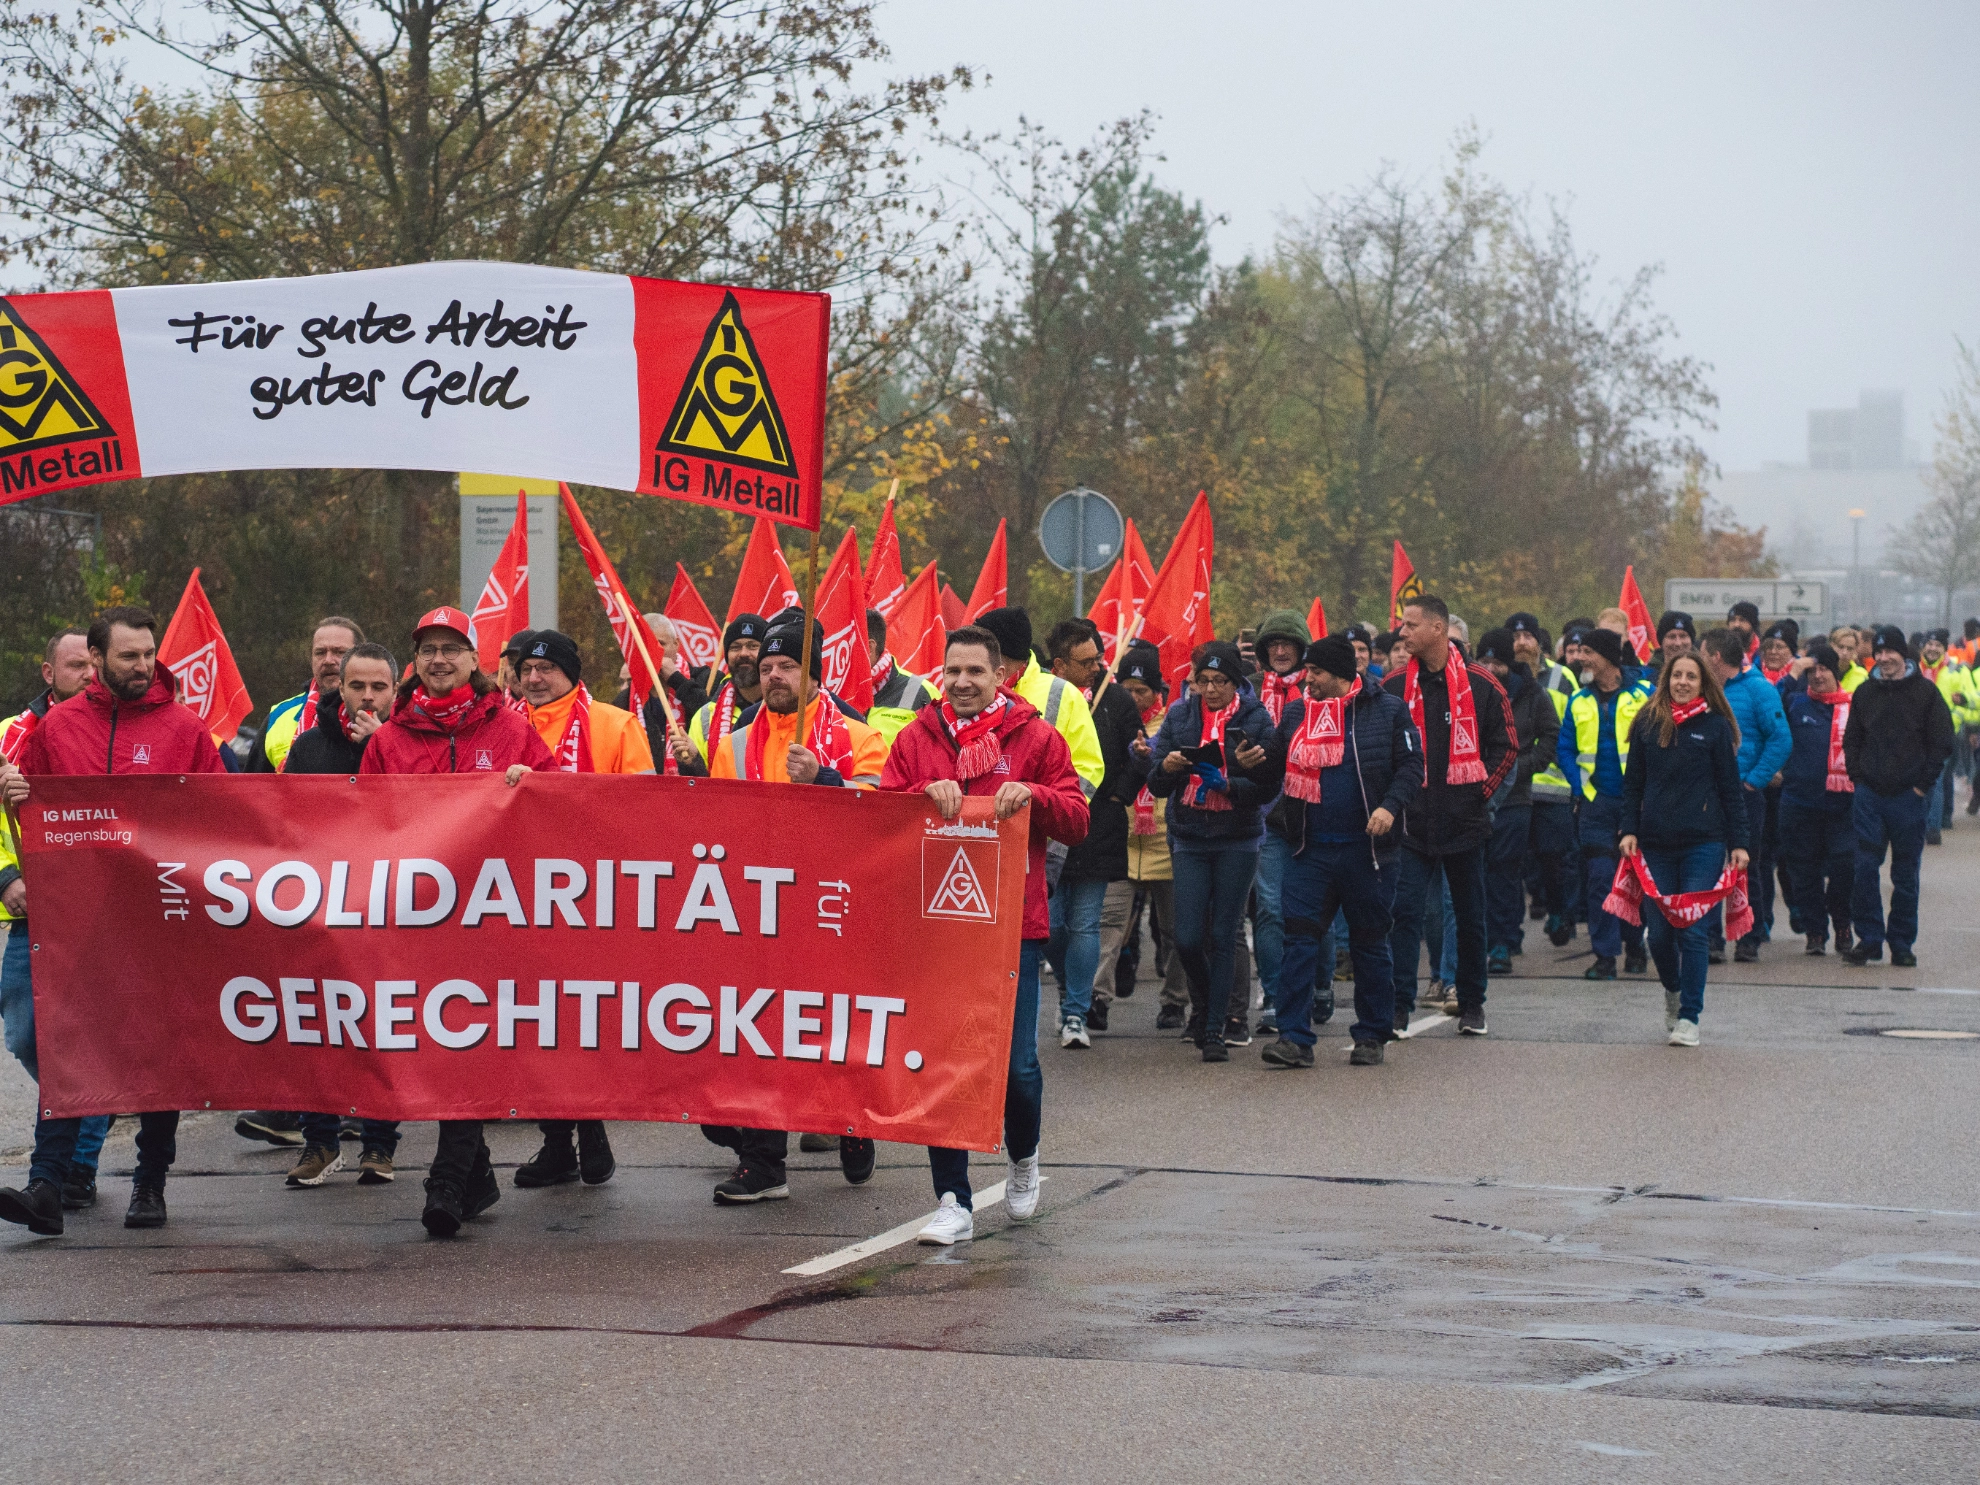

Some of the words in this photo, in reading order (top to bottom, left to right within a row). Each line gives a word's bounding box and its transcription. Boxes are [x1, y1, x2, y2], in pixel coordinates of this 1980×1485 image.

[168, 311, 284, 353] Für
[297, 301, 415, 358] gute
[425, 299, 587, 351] Arbeit
[401, 359, 530, 419] Geld
[1, 440, 123, 494] Metall
[652, 454, 690, 492] IG
[702, 464, 800, 517] Metall
[43, 810, 59, 822] IG
[62, 808, 119, 821] METALL
[45, 828, 132, 846] Regensburg
[157, 862, 190, 921] Mit
[203, 843, 795, 935] SOLIDARITÄT
[817, 879, 851, 937] für
[219, 976, 923, 1070] GERECHTIGKEIT.
